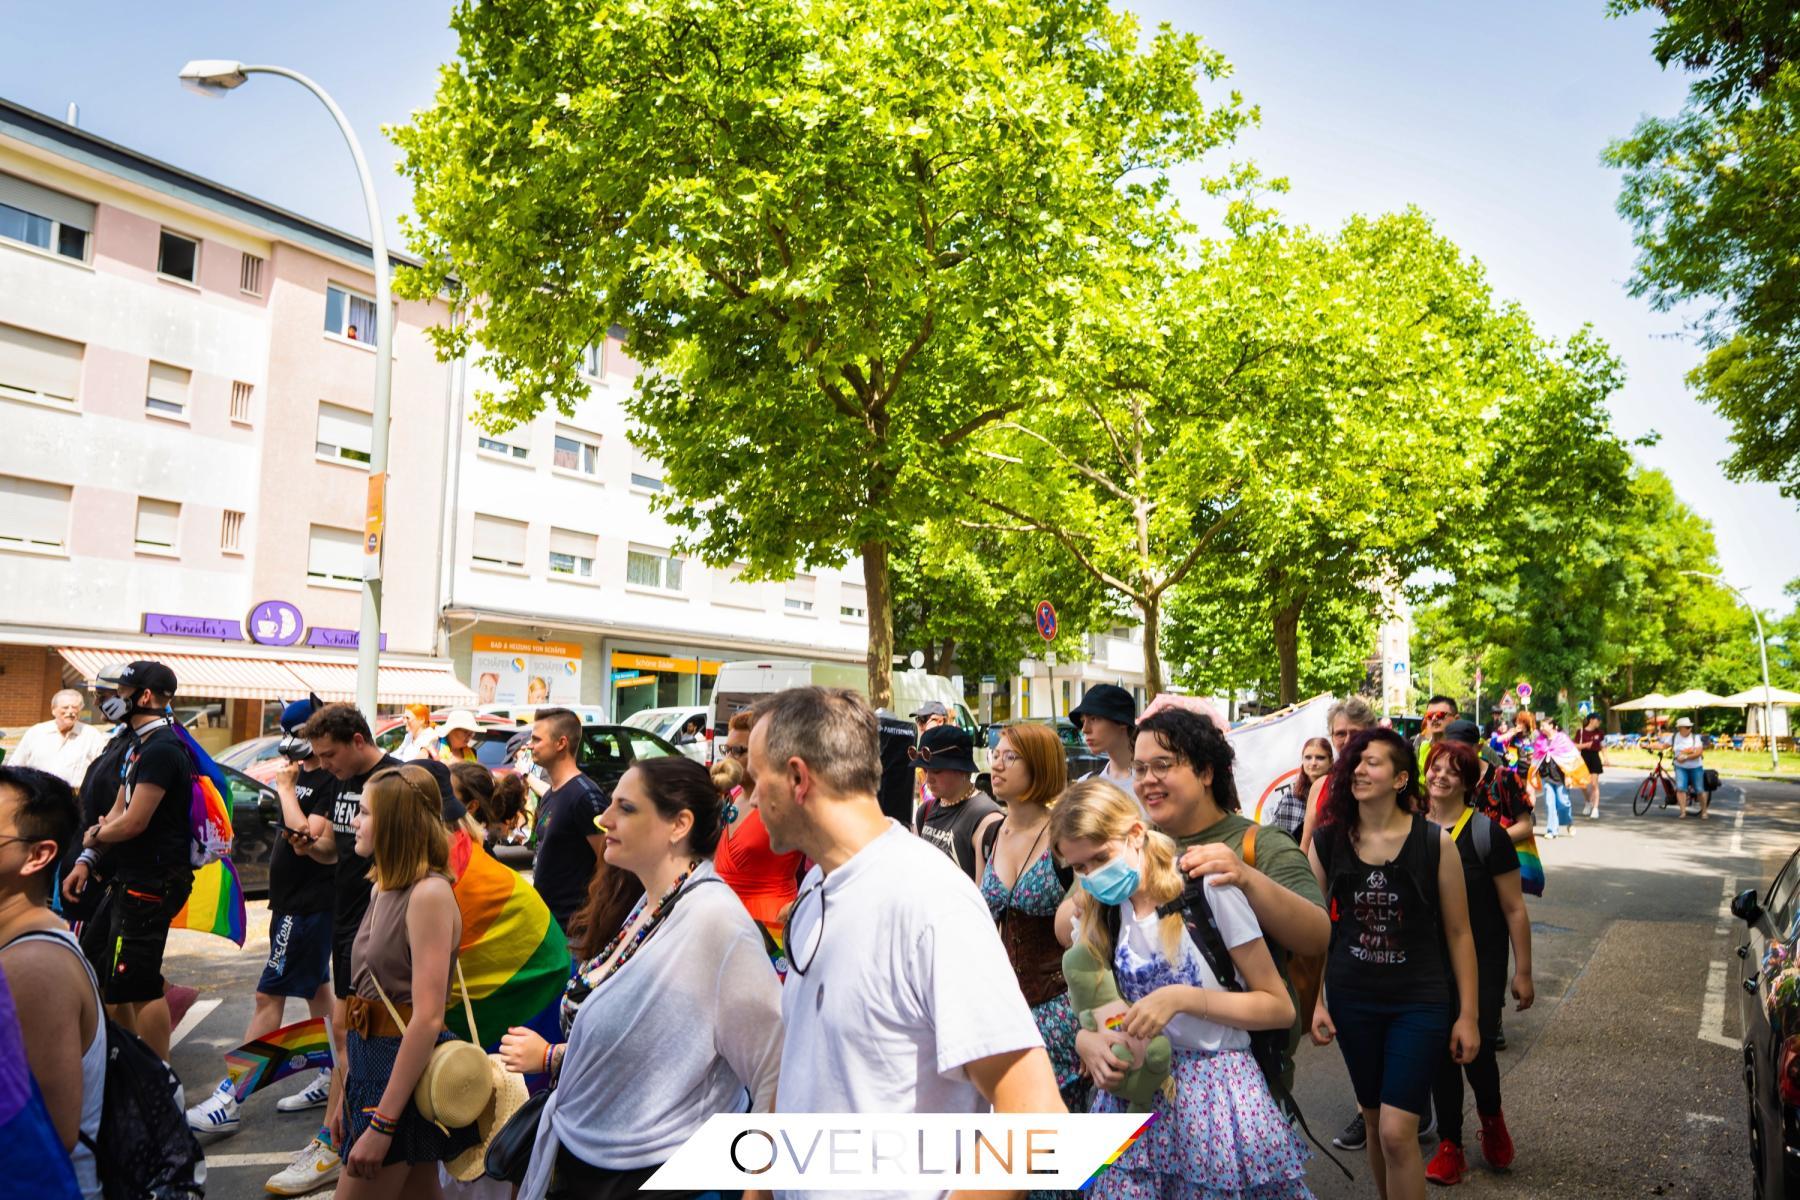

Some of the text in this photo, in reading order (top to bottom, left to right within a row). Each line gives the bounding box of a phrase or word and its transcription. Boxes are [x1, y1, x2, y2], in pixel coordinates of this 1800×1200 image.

[160, 618, 226, 635] Schneider's
[490, 641, 503, 649] BAD
[532, 644, 544, 653] VON
[333, 801, 357, 824] PEN
[1354, 892, 1399, 906] KEEP
[1354, 909, 1402, 922] CALM
[1349, 946, 1406, 964] ZOMBIES
